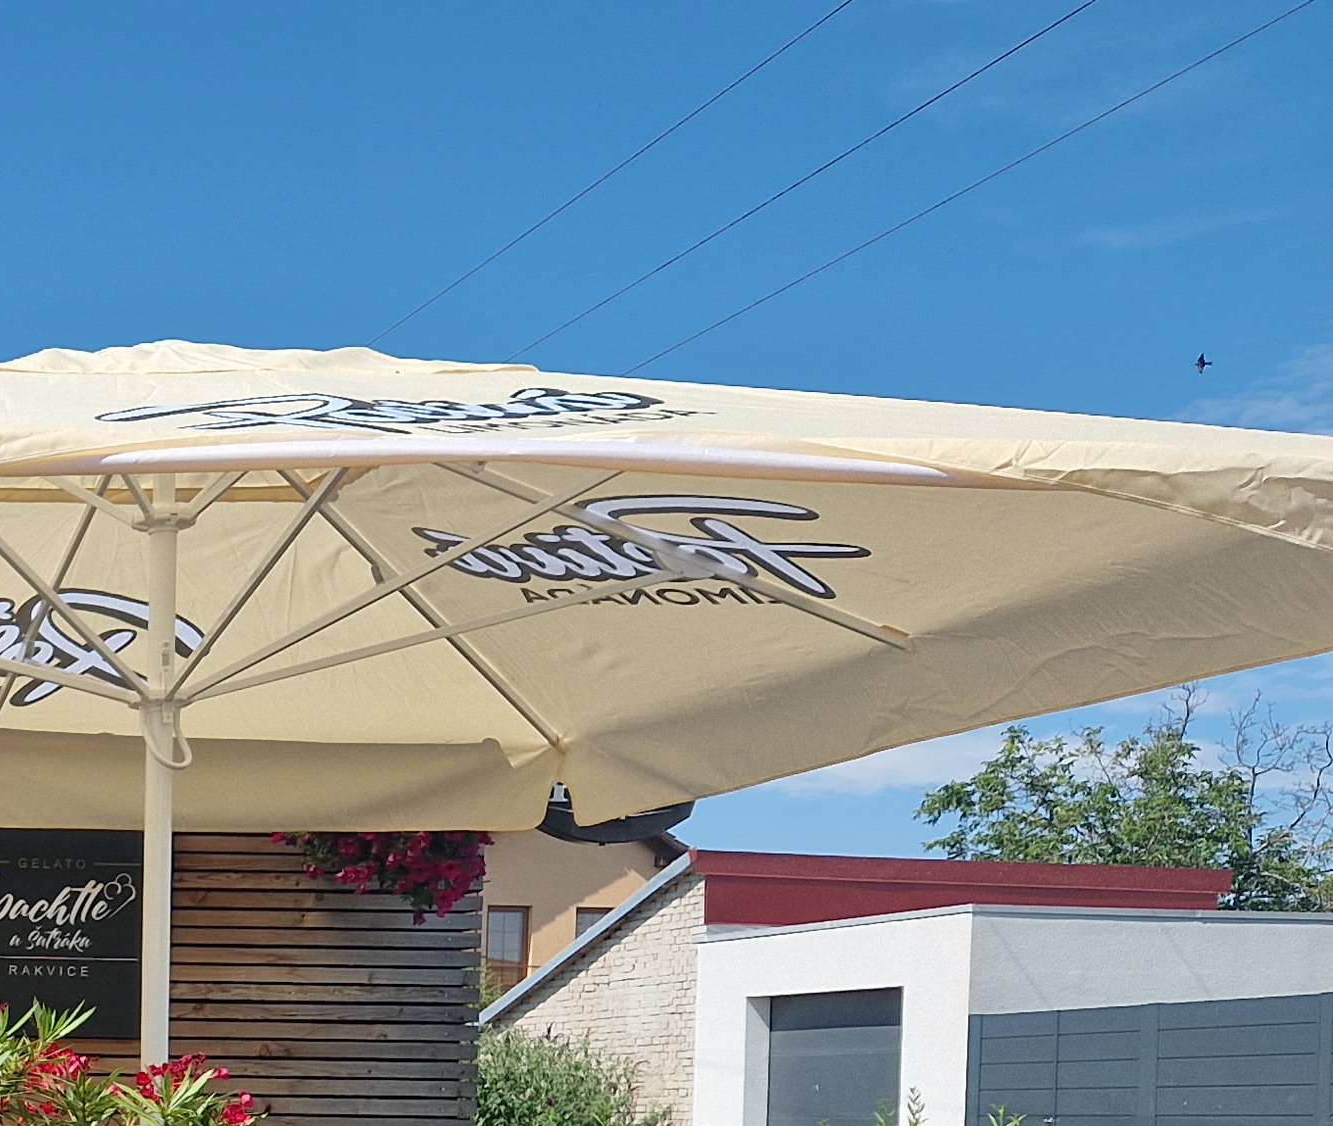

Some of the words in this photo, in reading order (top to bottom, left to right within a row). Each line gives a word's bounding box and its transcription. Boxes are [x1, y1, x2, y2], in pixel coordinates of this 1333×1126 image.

[18, 857, 86, 869] GELATO
[9, 933, 22, 947] a
[8, 964, 89, 977] RAKVICE
